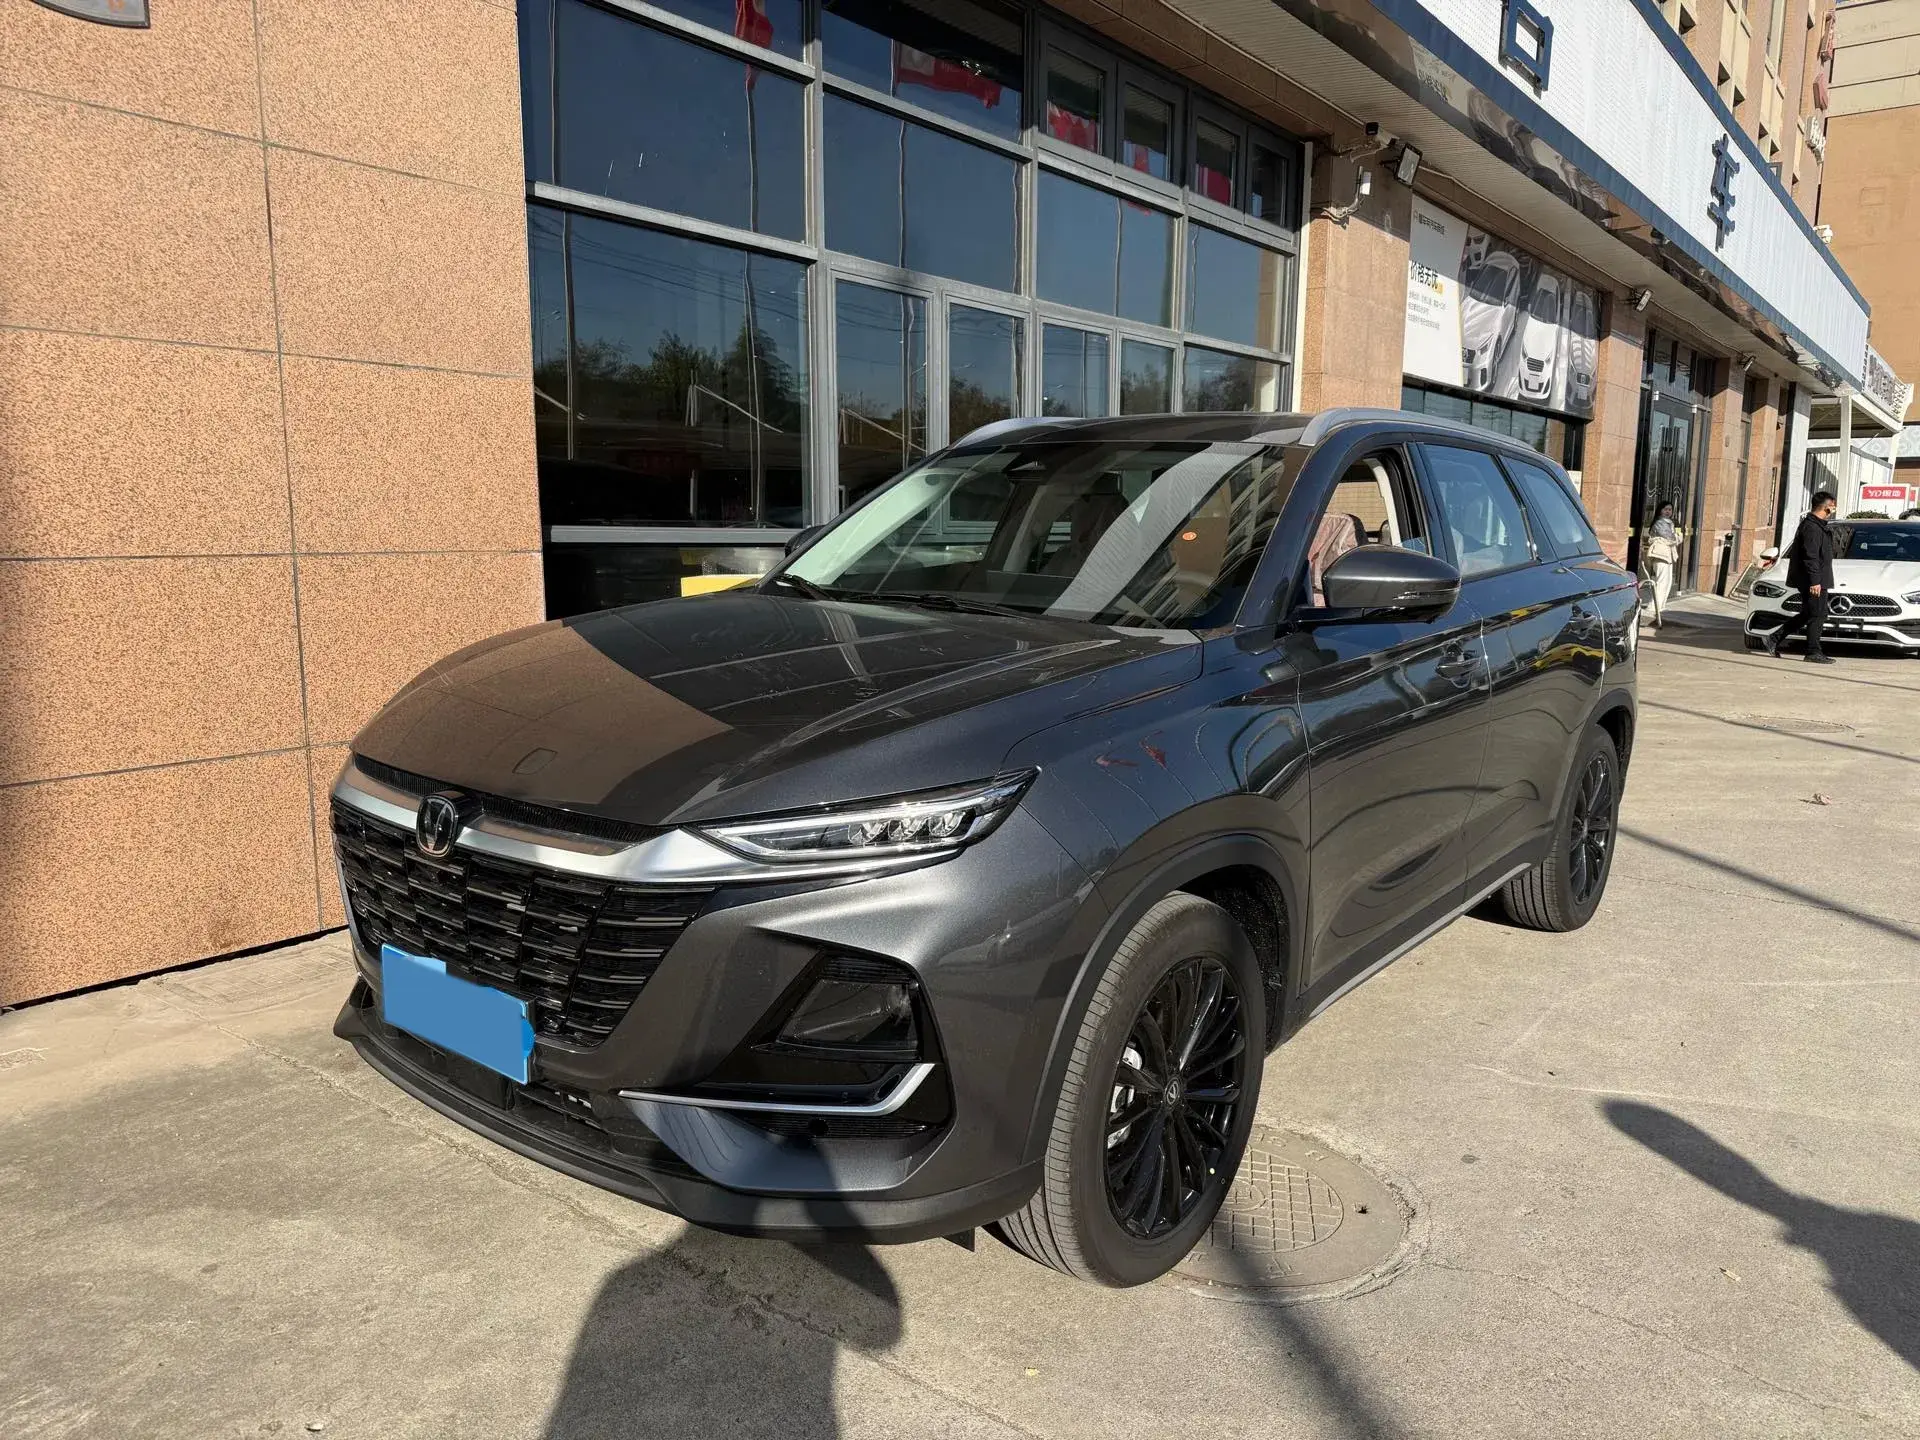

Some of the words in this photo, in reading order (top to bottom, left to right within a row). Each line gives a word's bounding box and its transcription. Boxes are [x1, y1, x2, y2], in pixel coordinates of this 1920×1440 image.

[1707, 132, 1740, 251] 车
[1410, 260, 1438, 290] 价格无忧
